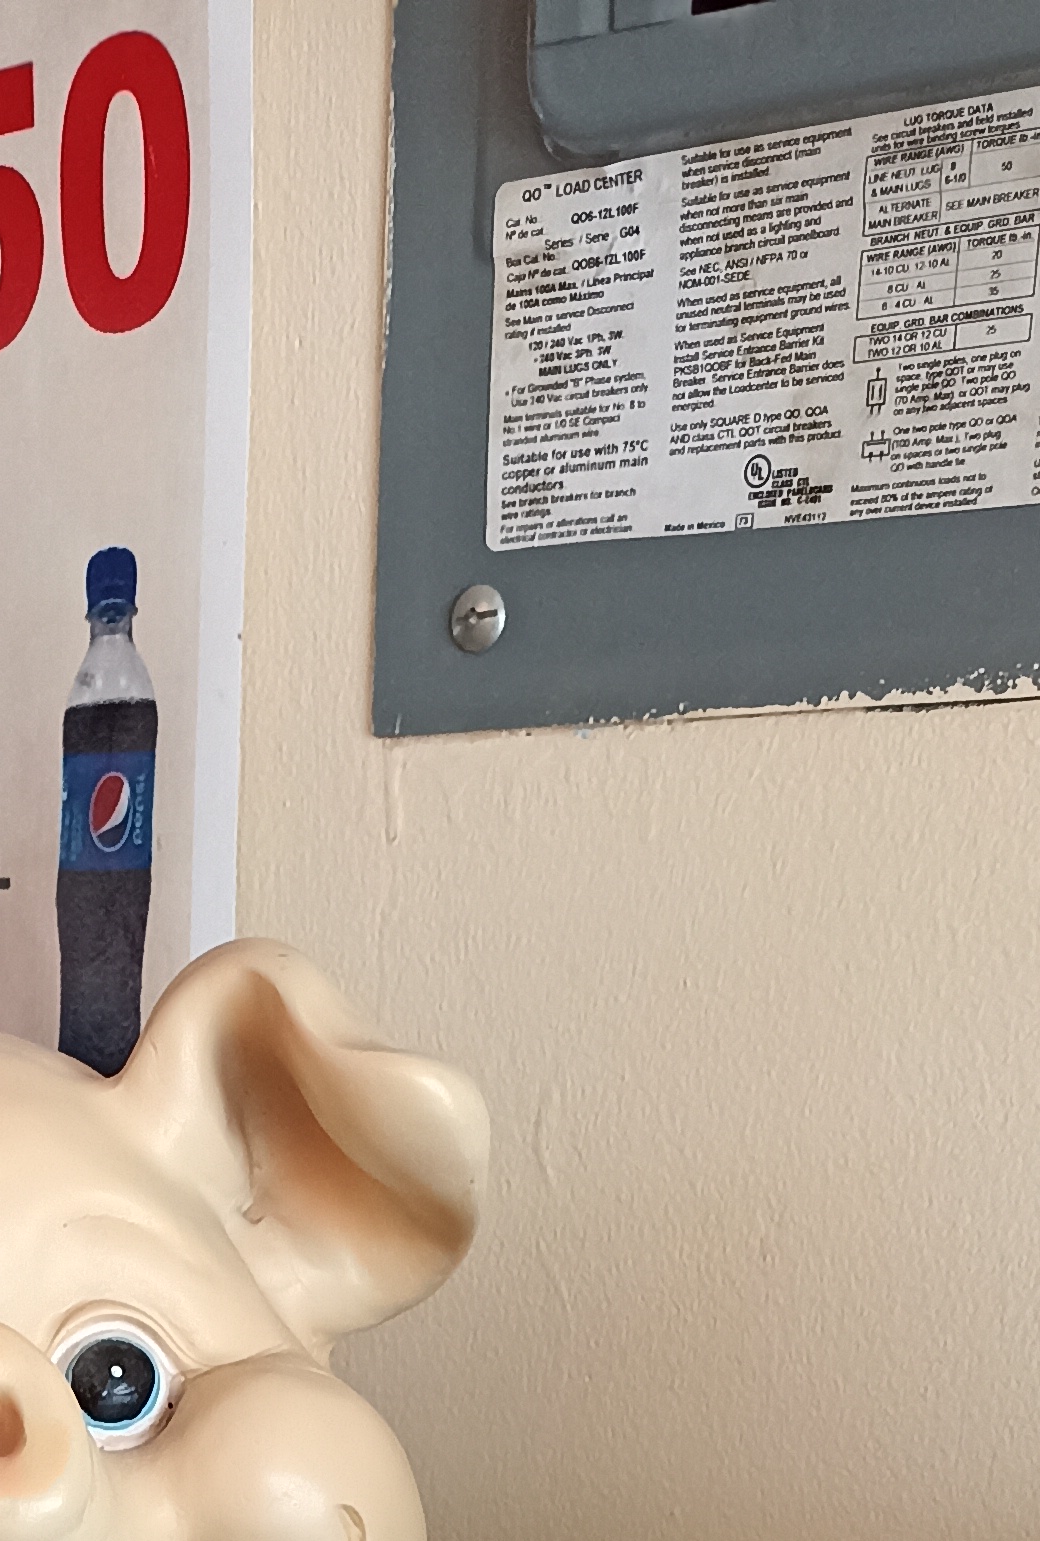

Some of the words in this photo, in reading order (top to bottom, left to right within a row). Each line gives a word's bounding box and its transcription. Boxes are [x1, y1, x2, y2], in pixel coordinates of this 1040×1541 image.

[904, 115, 923, 127] LUG
[926, 108, 965, 121] TORQUE
[968, 103, 993, 116] DATA
[874, 155, 897, 166] WIRE
[901, 149, 933, 162] RANGE
[936, 143, 964, 158] (AWG)
[946, 200, 963, 211] SEE
[967, 195, 991, 207] MAIN
[993, 188, 1039, 204] BREAKER
[868, 218, 891, 229] MAIN
[894, 211, 938, 225] BREAKER
[867, 252, 890, 262] WIRE
[893, 246, 925, 258] RANGE
[928, 242, 956, 255] (AWG)
[967, 235, 1006, 247] TORQUE
[503, 452, 548, 466] Suitable
[552, 449, 566, 460] for
[571, 449, 590, 459] use
[595, 444, 618, 455] with
[622, 440, 648, 452] 75°C
[502, 467, 540, 481] copper
[544, 466, 555, 475] or
[559, 461, 615, 473] aluminum
[619, 456, 648, 468] main
